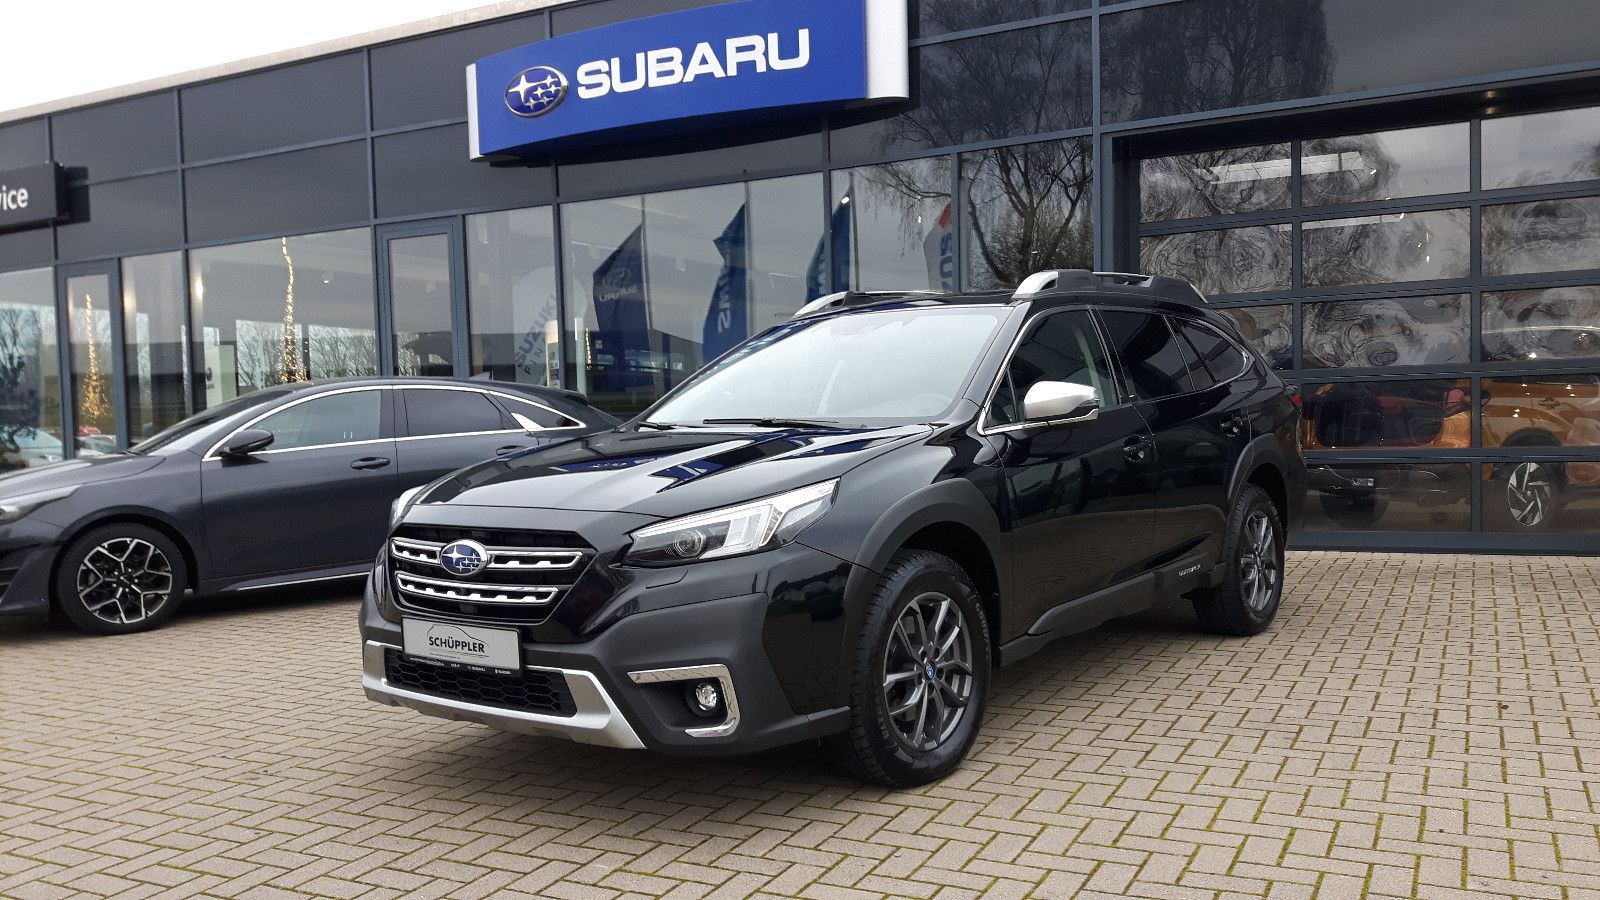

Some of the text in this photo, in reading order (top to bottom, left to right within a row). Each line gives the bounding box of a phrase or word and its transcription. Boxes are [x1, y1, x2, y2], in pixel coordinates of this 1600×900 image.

[576, 28, 810, 99] SUBARU
[0, 184, 29, 211] ice
[428, 636, 485, 653] SCHÜPPLER
